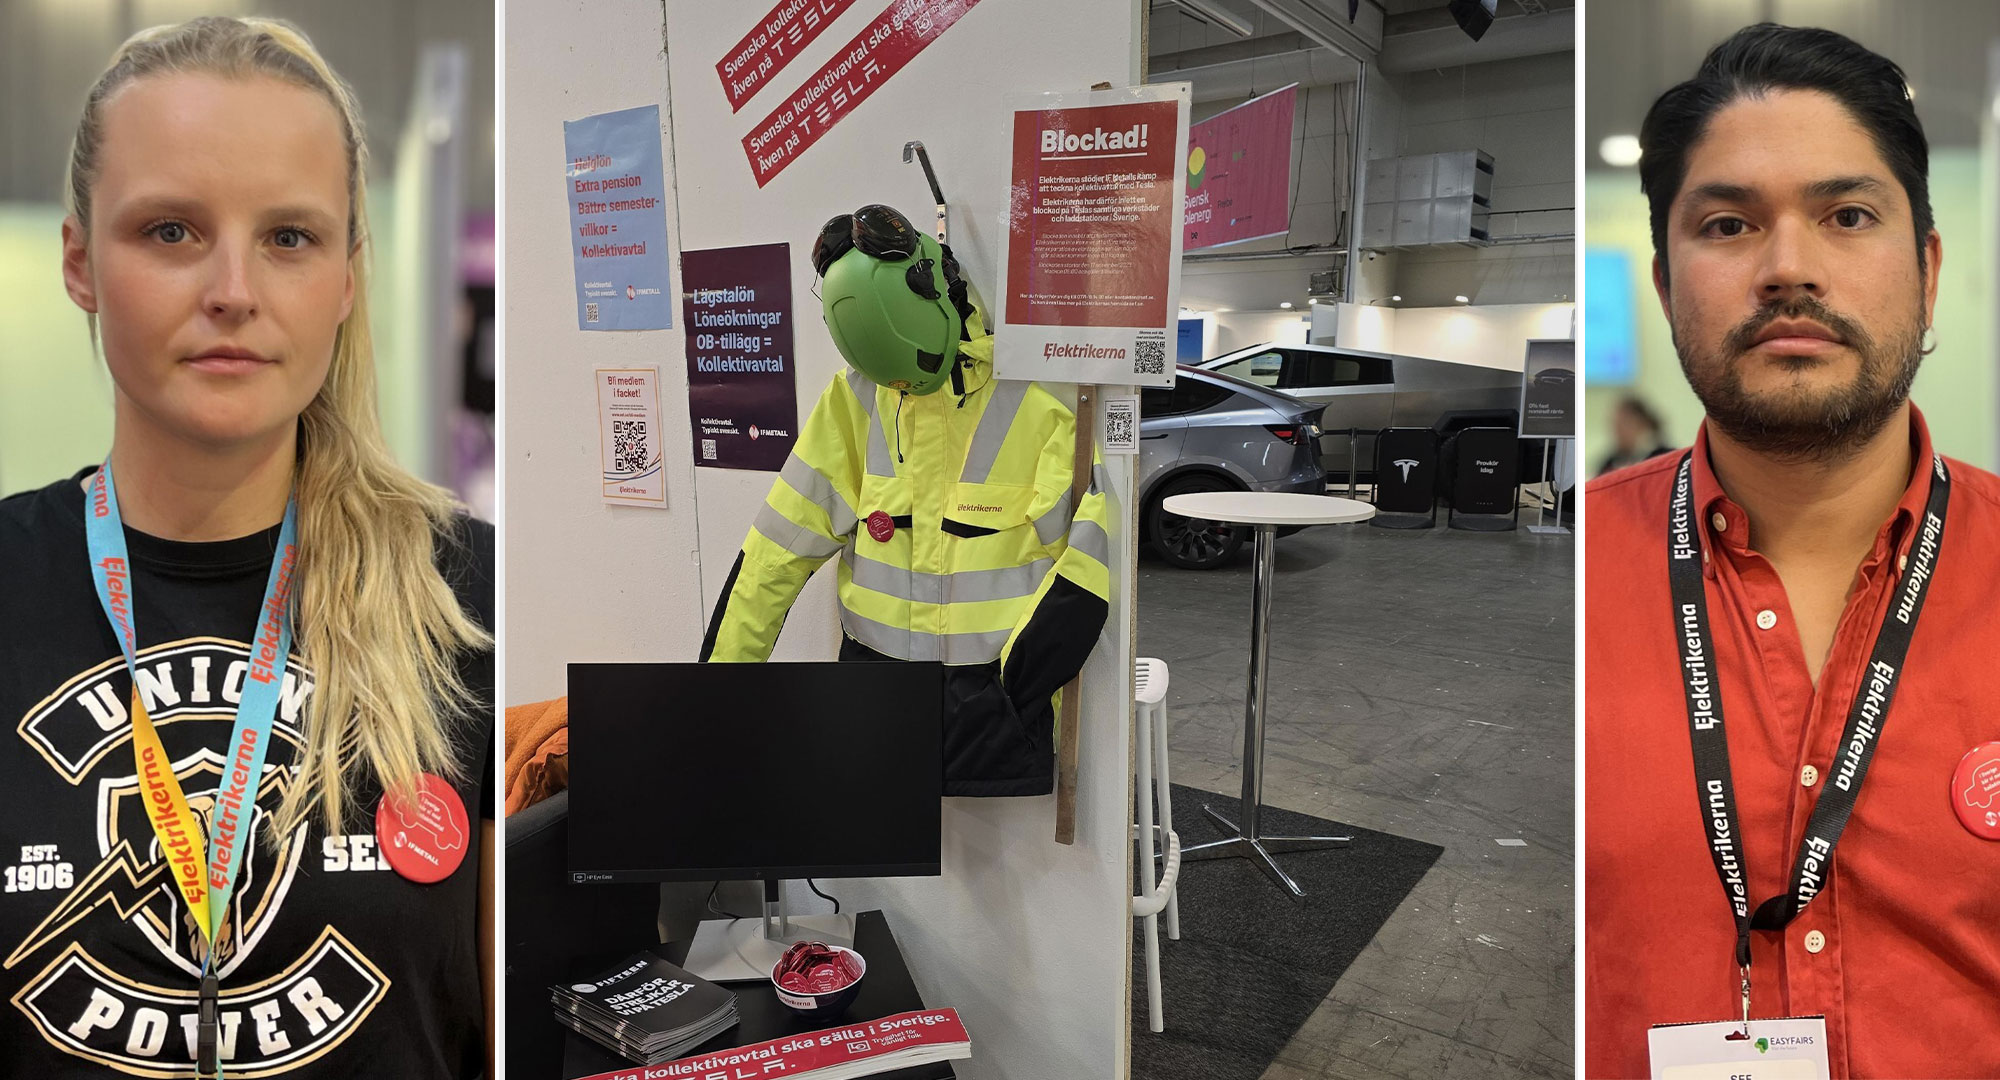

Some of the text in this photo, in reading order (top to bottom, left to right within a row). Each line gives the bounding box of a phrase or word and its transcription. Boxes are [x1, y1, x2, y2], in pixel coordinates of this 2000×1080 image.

[724, 33, 767, 78] Svenska
[731, 0, 842, 99] Även på TESL
[750, 110, 795, 154] Svenska
[792, 40, 869, 115] kollektivavtal
[869, 23, 891, 49] ska
[757, 58, 887, 175] Även på TESLA.
[1041, 124, 1148, 153] Blockad!
[574, 154, 612, 171] Helglön
[575, 174, 641, 193] Extra pension
[1039, 175, 1080, 184] Elektrikerna
[1081, 174, 1104, 184] stödjer
[1050, 184, 1073, 192] teckna
[1120, 182, 1135, 190] med
[1136, 181, 1156, 189] Tesla.
[578, 197, 660, 215] Bättre semester-
[1033, 206, 1060, 214] blockad
[1061, 206, 1071, 216] på
[1071, 206, 1093, 214] Teslas
[1122, 203, 1160, 212] verkstäder
[1042, 197, 1083, 206] Elektrikerna
[1084, 197, 1096, 205] har
[1096, 196, 1117, 205] därför
[1051, 214, 1065, 222] och
[1065, 213, 1109, 222] laddstationer
[1113, 213, 1141, 224] Sverige.
[1184, 205, 1212, 225] olenergi
[579, 222, 609, 237] villkor
[581, 241, 646, 258] Kollektivavtal
[693, 285, 755, 308] Lägstalön
[694, 309, 782, 329] Löneökningar
[696, 332, 772, 353] OB-tillägg =
[1043, 342, 1126, 363] Elektrikerna
[697, 355, 783, 372] Kollektivavtal
[608, 376, 645, 386] Bli medlem
[617, 388, 641, 398] facket!
[1673, 458, 1697, 560] Elektrikerna
[1896, 511, 1942, 624] Elektrikerna
[249, 543, 299, 685] Elektrikerna
[1681, 603, 1721, 730] Elektrikerna
[1835, 660, 1895, 792] Elektrikerna
[210, 728, 258, 890] Elektrikerna
[142, 746, 206, 904] Elektrikerna
[21, 844, 61, 861] EST.
[1707, 779, 1747, 917] Elektrikerna
[4, 862, 74, 893] 1906
[596, 960, 648, 988] FIFTEEN
[604, 977, 668, 1005] DÄRFÖR
[609, 979, 683, 1011] STREJKAR
[616, 983, 696, 1016] VI PÅ TESLA
[68, 976, 345, 1060] POWER
[644, 1045, 777, 1079] kollektivavtal
[782, 1037, 815, 1054] ska
[819, 1029, 866, 1047] gälla
[869, 1026, 876, 1036] i
[878, 1013, 951, 1033] Sverige.
[1770, 1036, 1814, 1046] EASYFAIRS
